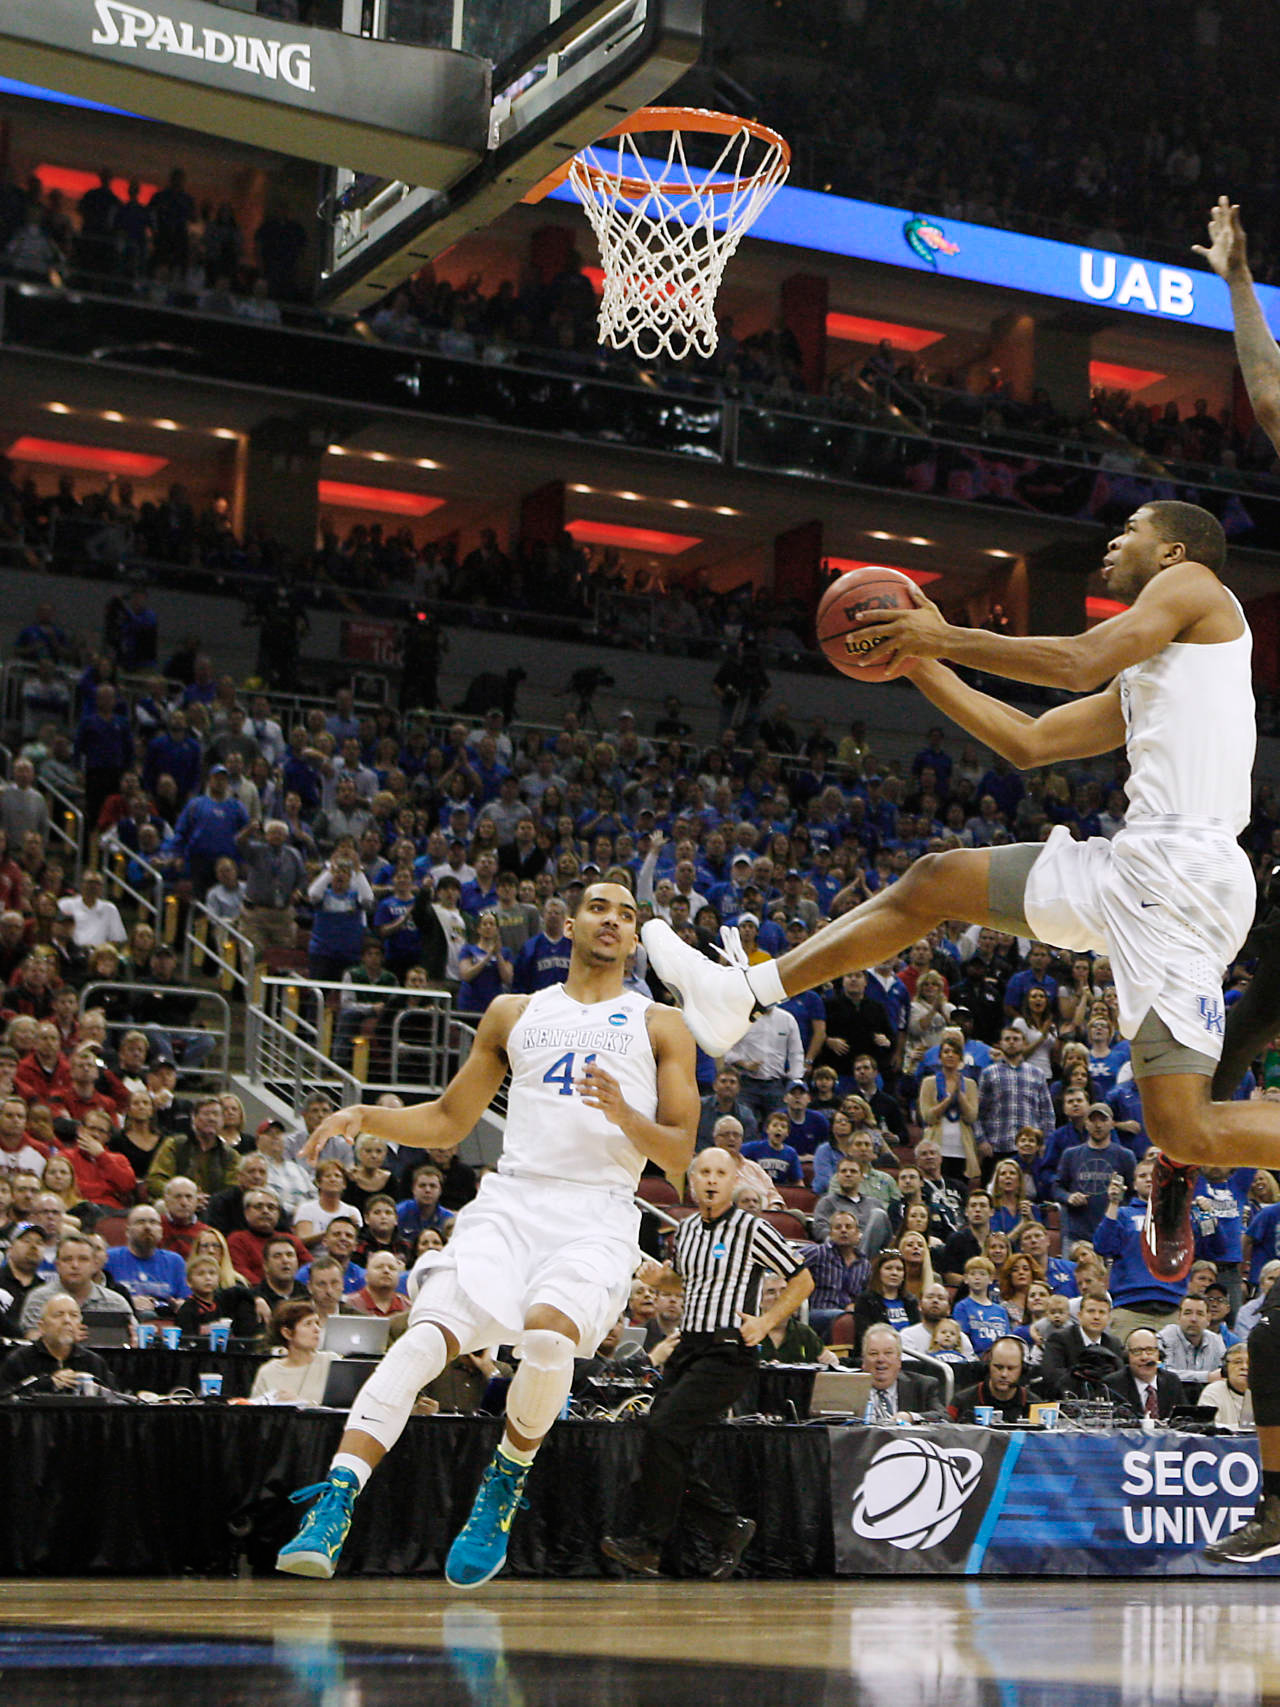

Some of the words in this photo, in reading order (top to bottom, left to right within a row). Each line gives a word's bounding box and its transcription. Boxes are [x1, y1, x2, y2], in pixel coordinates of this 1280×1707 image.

[92, 0, 311, 91] SPALDING
[1080, 252, 1194, 316] UAB
[537, 956, 571, 971] KENTUCK
[523, 1028, 634, 1055] KENTUCKY
